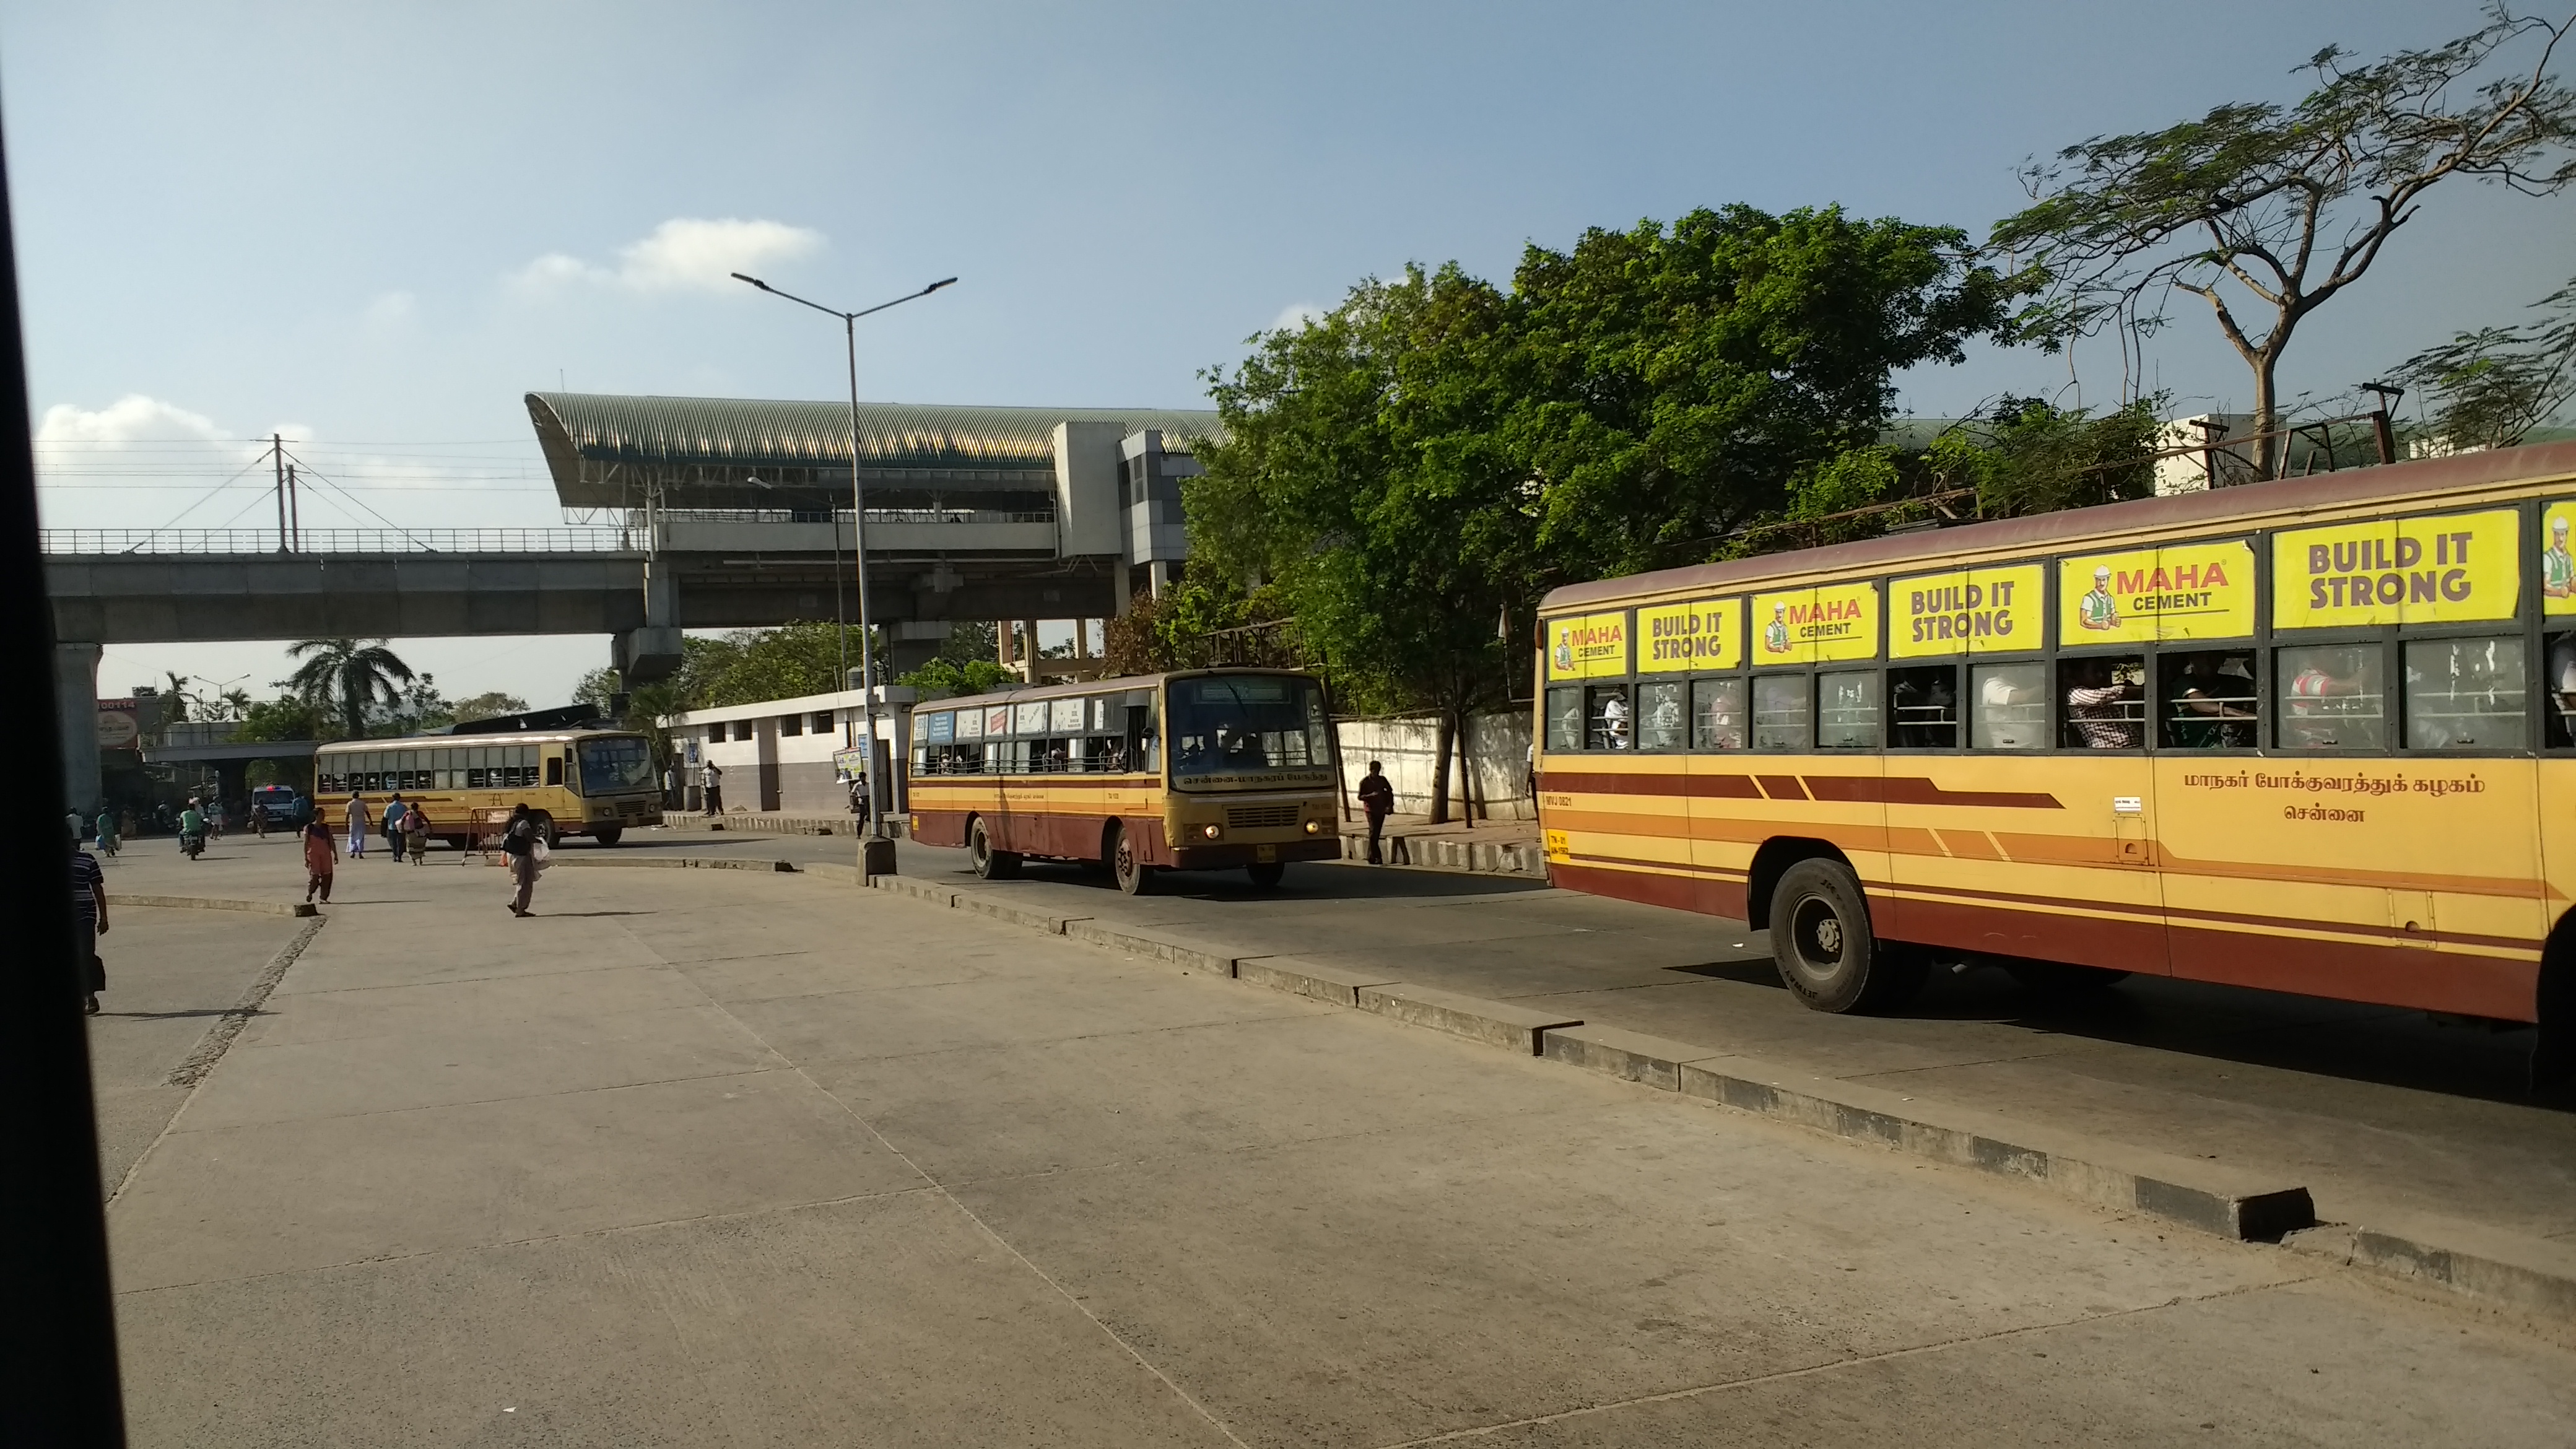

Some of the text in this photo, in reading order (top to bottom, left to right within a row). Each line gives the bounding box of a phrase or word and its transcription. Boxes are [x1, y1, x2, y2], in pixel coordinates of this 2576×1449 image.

[2308, 531, 2473, 575] BUILD IT
[2117, 563, 2229, 595] MAHA
[2309, 568, 2472, 610] STRONG
[1911, 581, 2014, 615] BUILD IT
[2132, 591, 2212, 611] CEMENT
[1788, 599, 1862, 624] MAHA
[1572, 625, 1622, 646] MAHA
[1652, 612, 1722, 637] BUILD IT
[1800, 622, 1851, 638] CEMENT
[1912, 609, 2013, 642] STRONG
[1578, 645, 1616, 658] CEMENT
[1653, 635, 1721, 660] STRONG
[2184, 770, 2486, 797] மாநகர் போக்குவரத்துக் கழகம்
[2284, 803, 2365, 822] சென்னை
